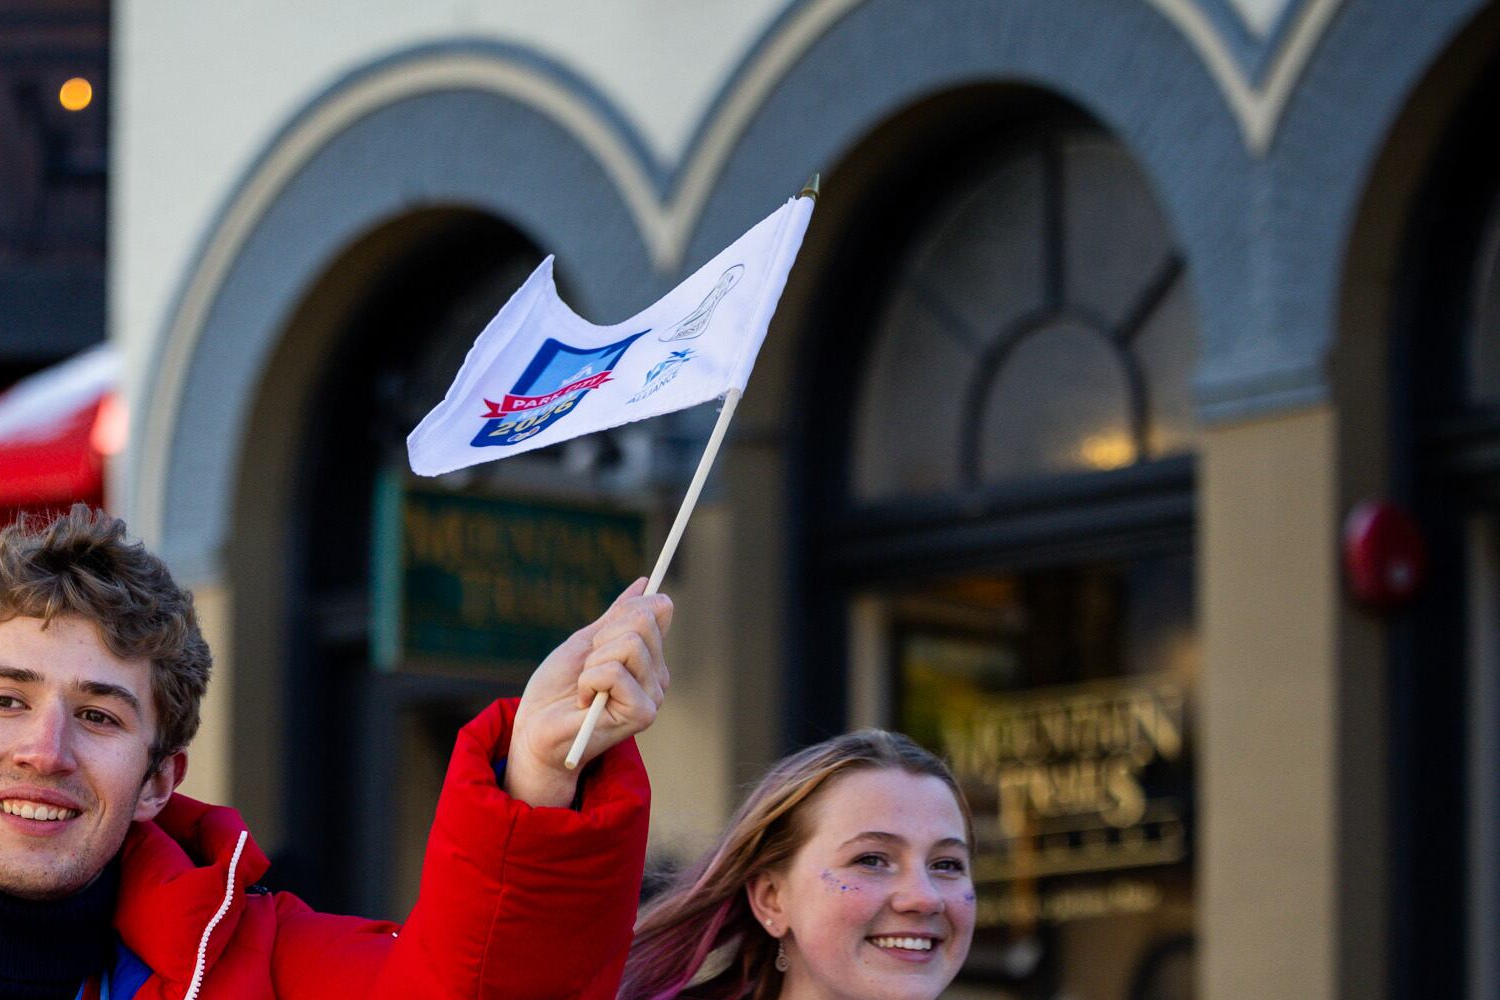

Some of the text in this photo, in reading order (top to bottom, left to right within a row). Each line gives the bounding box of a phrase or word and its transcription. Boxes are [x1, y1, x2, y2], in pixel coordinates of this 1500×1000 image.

[512, 393, 561, 409] PARK
[564, 375, 602, 393] CITY
[488, 396, 577, 437] 2026
